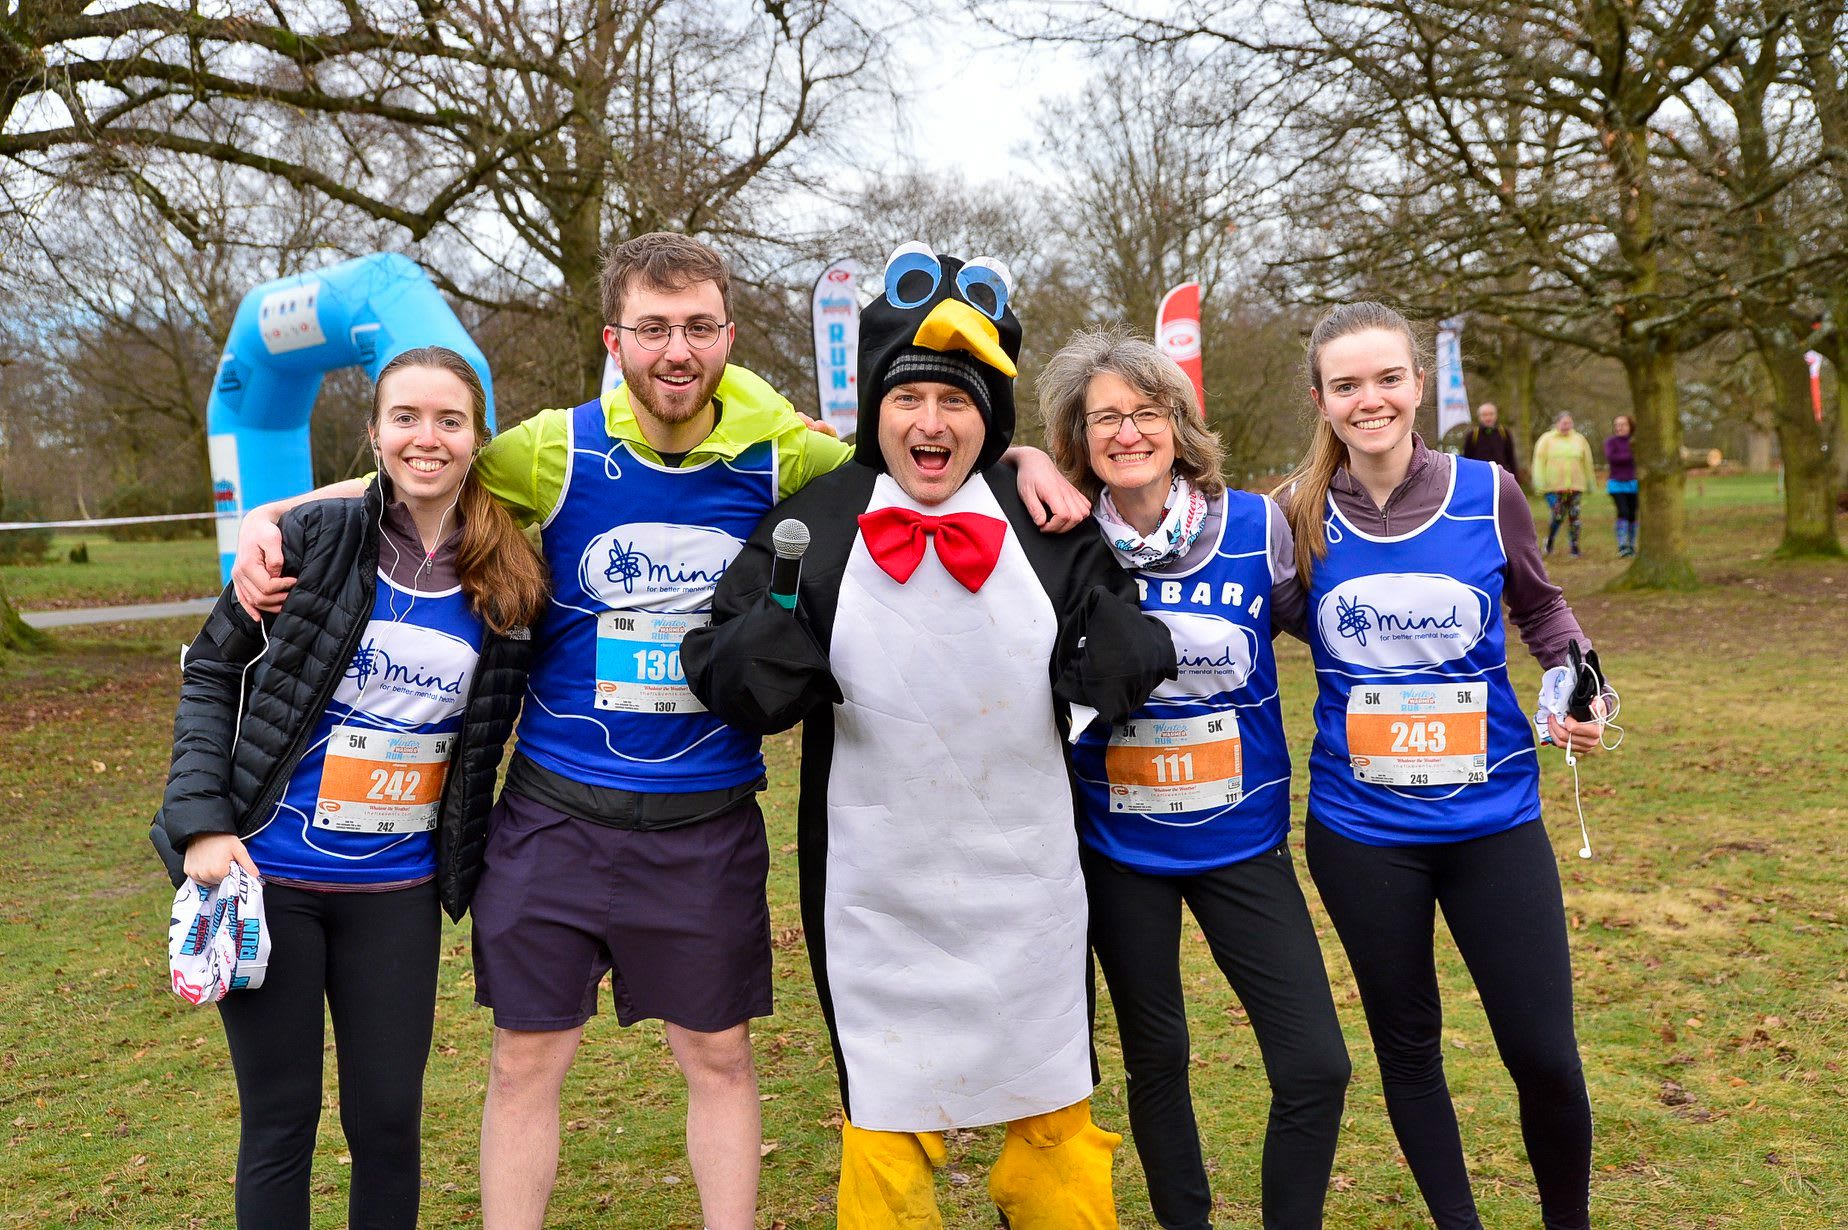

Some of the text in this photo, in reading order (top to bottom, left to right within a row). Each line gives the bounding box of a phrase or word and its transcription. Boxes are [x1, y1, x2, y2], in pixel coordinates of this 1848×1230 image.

[614, 618, 635, 631] 10K
[1377, 606, 1462, 631] mind
[1177, 646, 1236, 666] ind
[633, 650, 685, 681] 130
[384, 663, 464, 694] mind
[392, 686, 414, 696] better
[414, 691, 438, 700] mental
[1364, 692, 1380, 705] 5K
[1457, 691, 1472, 704] 5K
[654, 702, 676, 712] 1307
[1122, 725, 1136, 738] 5K
[1208, 719, 1223, 734] 5K
[349, 734, 367, 749] 5K
[1391, 722, 1446, 752] 243
[435, 740, 447, 754] 5K
[1152, 752, 1194, 782] 111
[1410, 774, 1428, 784] 243
[1468, 772, 1484, 782] 243
[366, 769, 420, 800] 242
[1225, 793, 1238, 803] 111
[1169, 802, 1183, 811] 111
[376, 822, 394, 832] 242
[426, 819, 436, 830] 242
[239, 918, 260, 961] RUN
